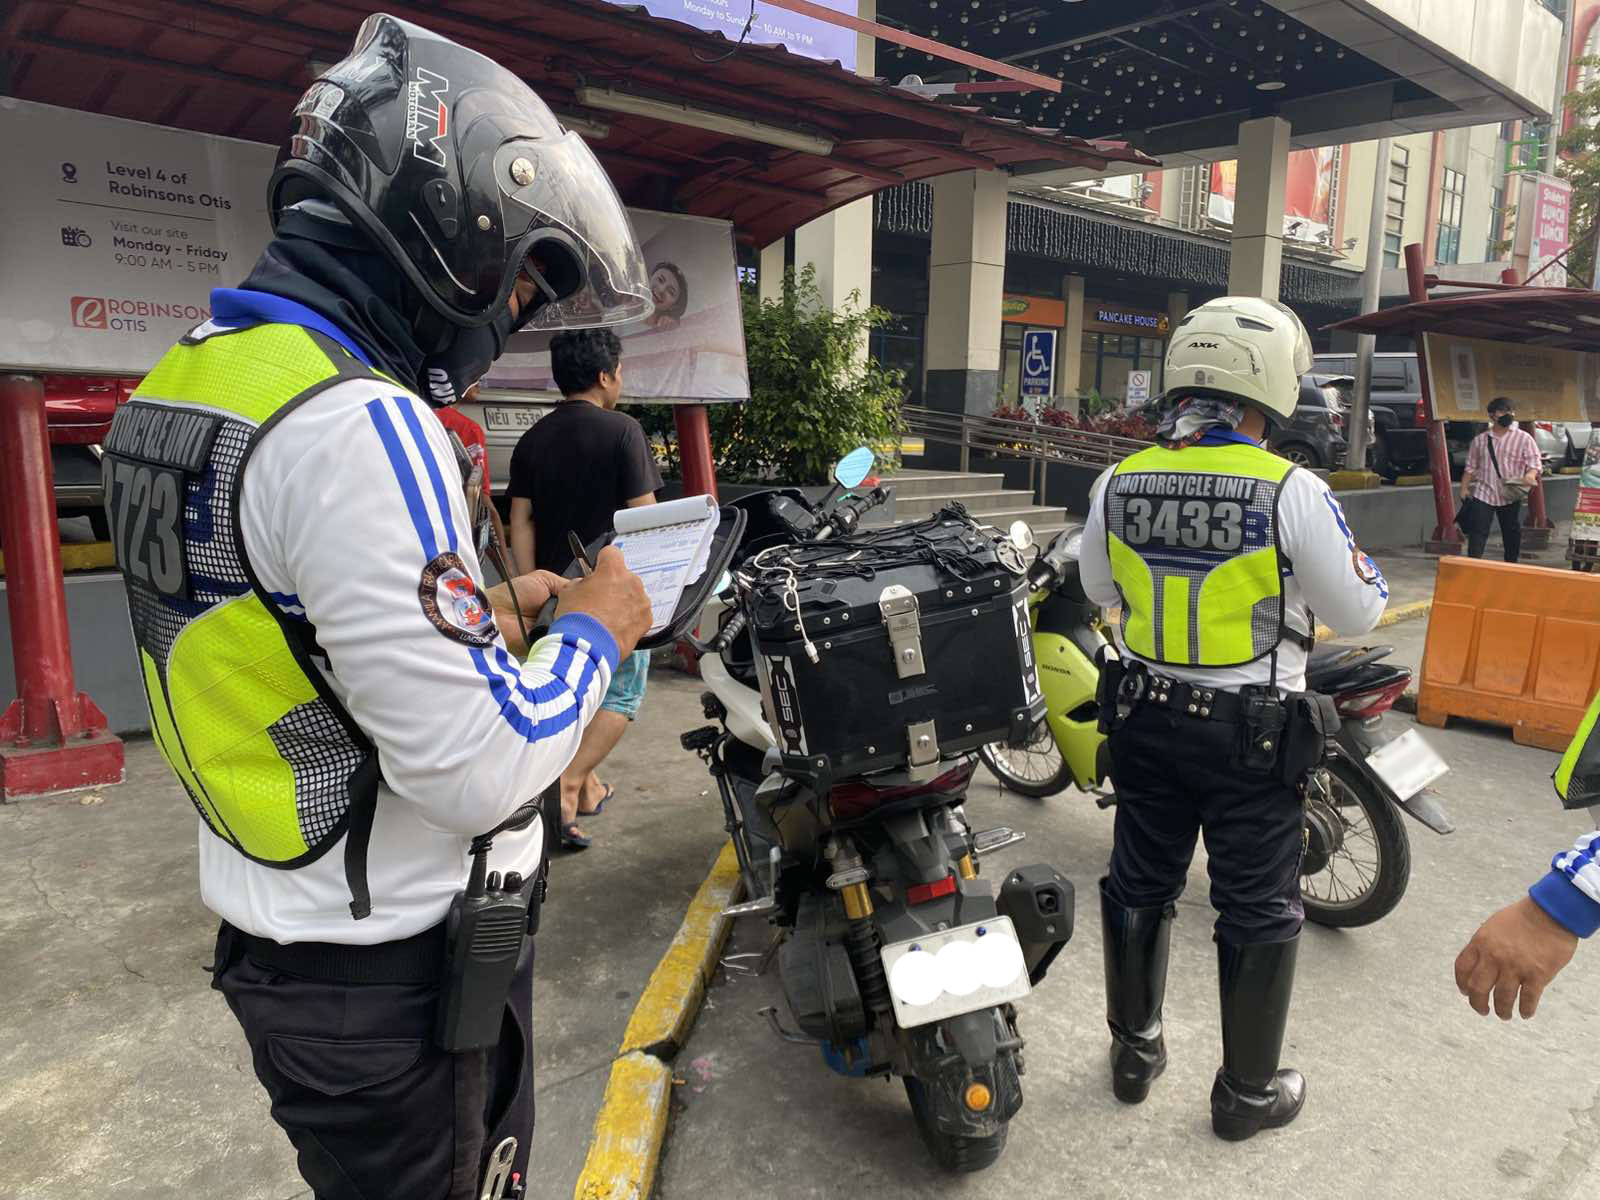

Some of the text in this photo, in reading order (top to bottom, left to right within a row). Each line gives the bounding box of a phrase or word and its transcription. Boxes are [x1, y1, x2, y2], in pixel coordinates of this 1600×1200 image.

[106, 161, 188, 185] Level 4 of
[109, 180, 232, 210] Robinsons Otis
[110, 219, 189, 240] Visit our site
[113, 236, 172, 256] Monday
[186, 245, 229, 262] Friday
[114, 253, 147, 267] 9:00
[151, 258, 172, 270] AM
[187, 261, 196, 272] 5
[198, 262, 219, 274] PM
[109, 299, 212, 320] ROBINSON
[1099, 311, 1158, 328] PANCAKE HOUSE
[110, 318, 147, 332] OTIS
[1116, 474, 1256, 499] MOTORCYCLE UNIT
[103, 453, 183, 594] 723
[1126, 497, 1242, 551] 3433
[1042, 663, 1072, 675] HONDA
